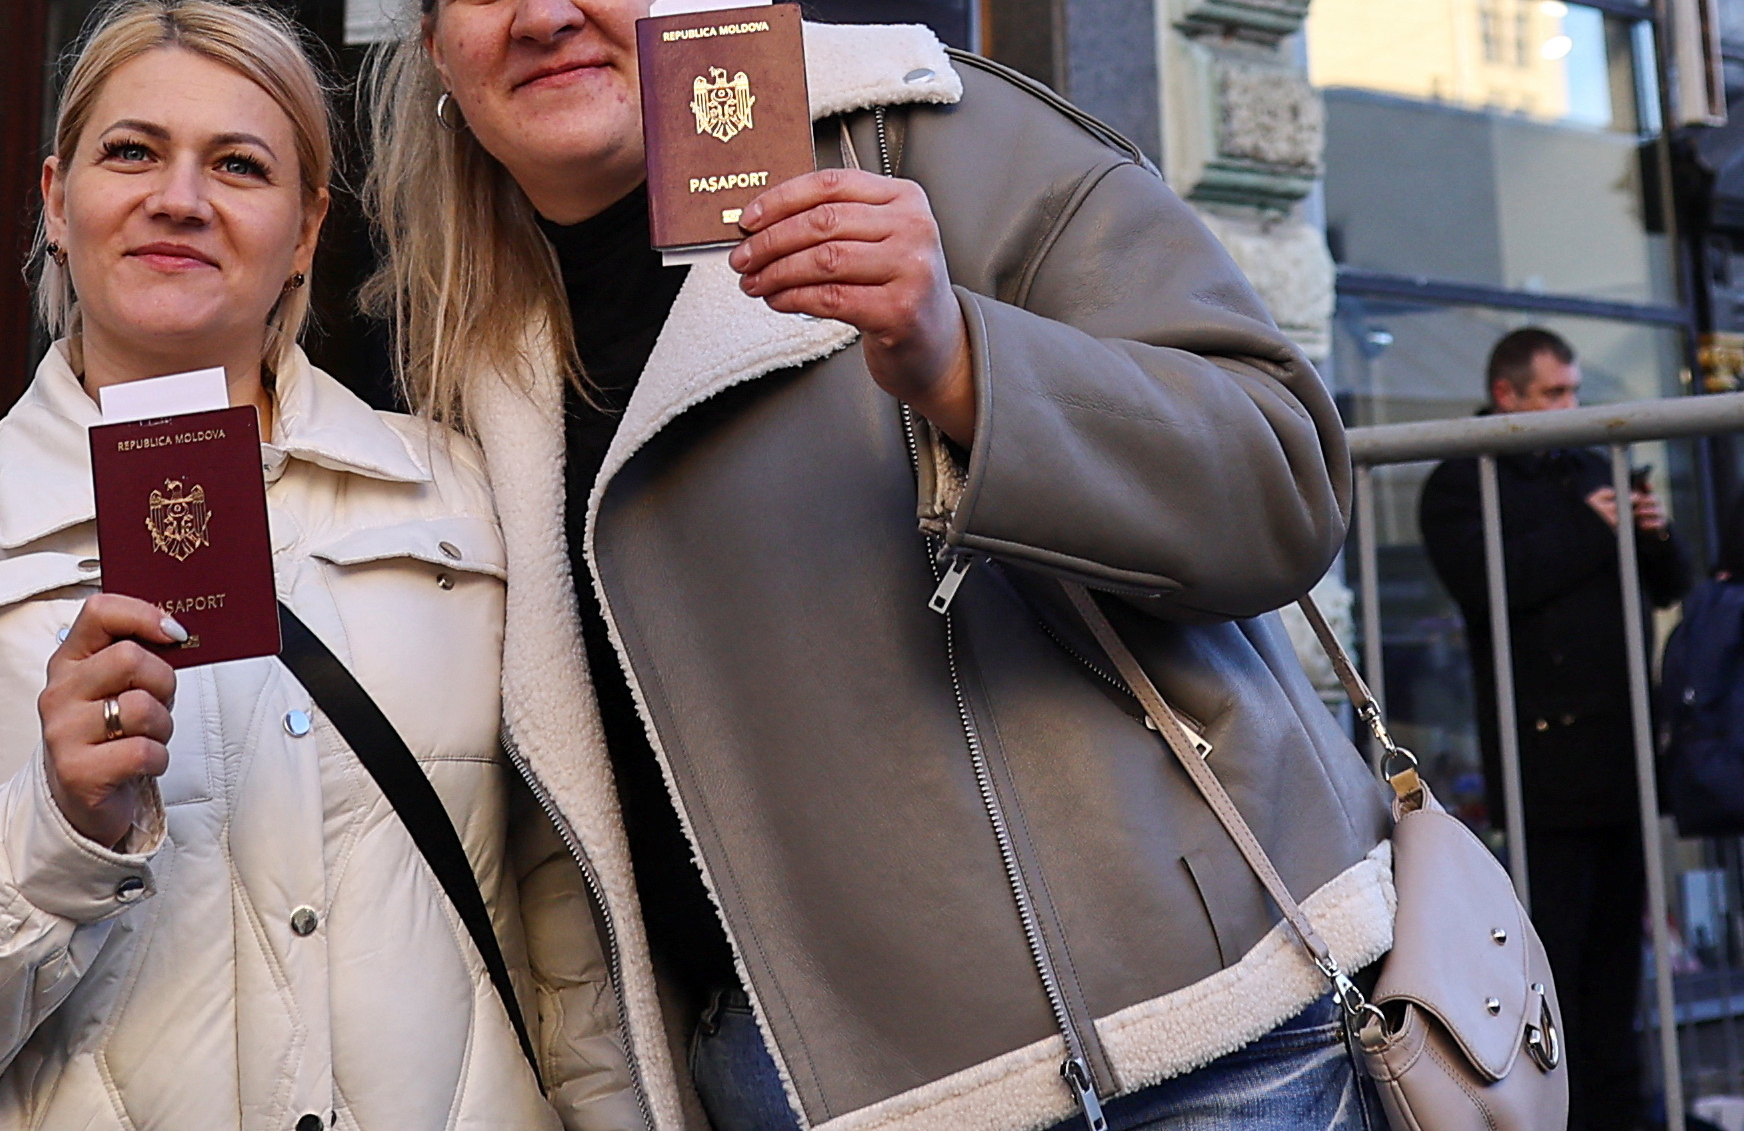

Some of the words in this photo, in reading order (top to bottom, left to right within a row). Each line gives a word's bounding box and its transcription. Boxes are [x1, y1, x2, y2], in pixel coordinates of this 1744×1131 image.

[662, 27, 718, 42] REPUBLICA
[718, 21, 770, 37] MOLDOVA
[117, 436, 173, 452] REPUBLICA
[174, 428, 226, 444] MOLDOVA
